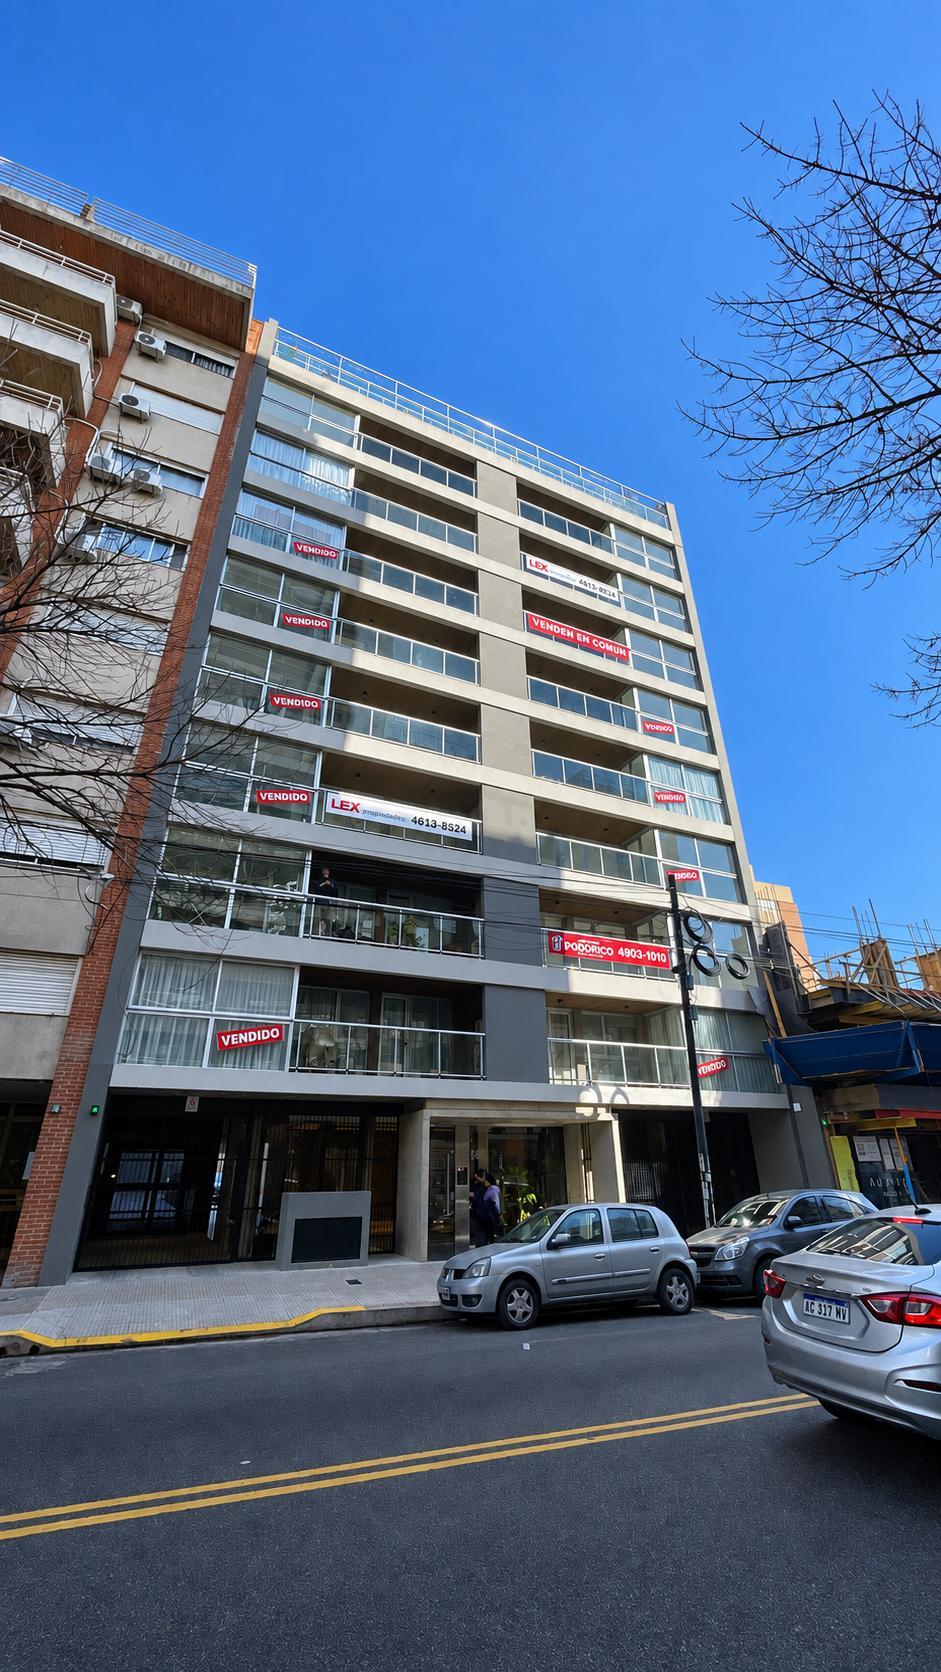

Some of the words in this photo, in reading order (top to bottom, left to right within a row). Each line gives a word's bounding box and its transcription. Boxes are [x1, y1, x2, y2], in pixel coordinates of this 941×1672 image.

[296, 543, 337, 558] VENDIDO
[529, 559, 549, 573] LEX
[285, 615, 328, 628] VENDIDO
[532, 617, 574, 639] VENDEN
[576, 632, 590, 644] EN
[592, 639, 627, 657] COMUN
[273, 696, 319, 708] VENDIDO
[259, 792, 309, 801] VENDIDO
[331, 798, 361, 813] LEX
[564, 940, 614, 956] PODORICO
[617, 946, 667, 963] 4903-1010
[221, 1027, 280, 1046] VENDIDO
[817, 1303, 833, 1318] 317
